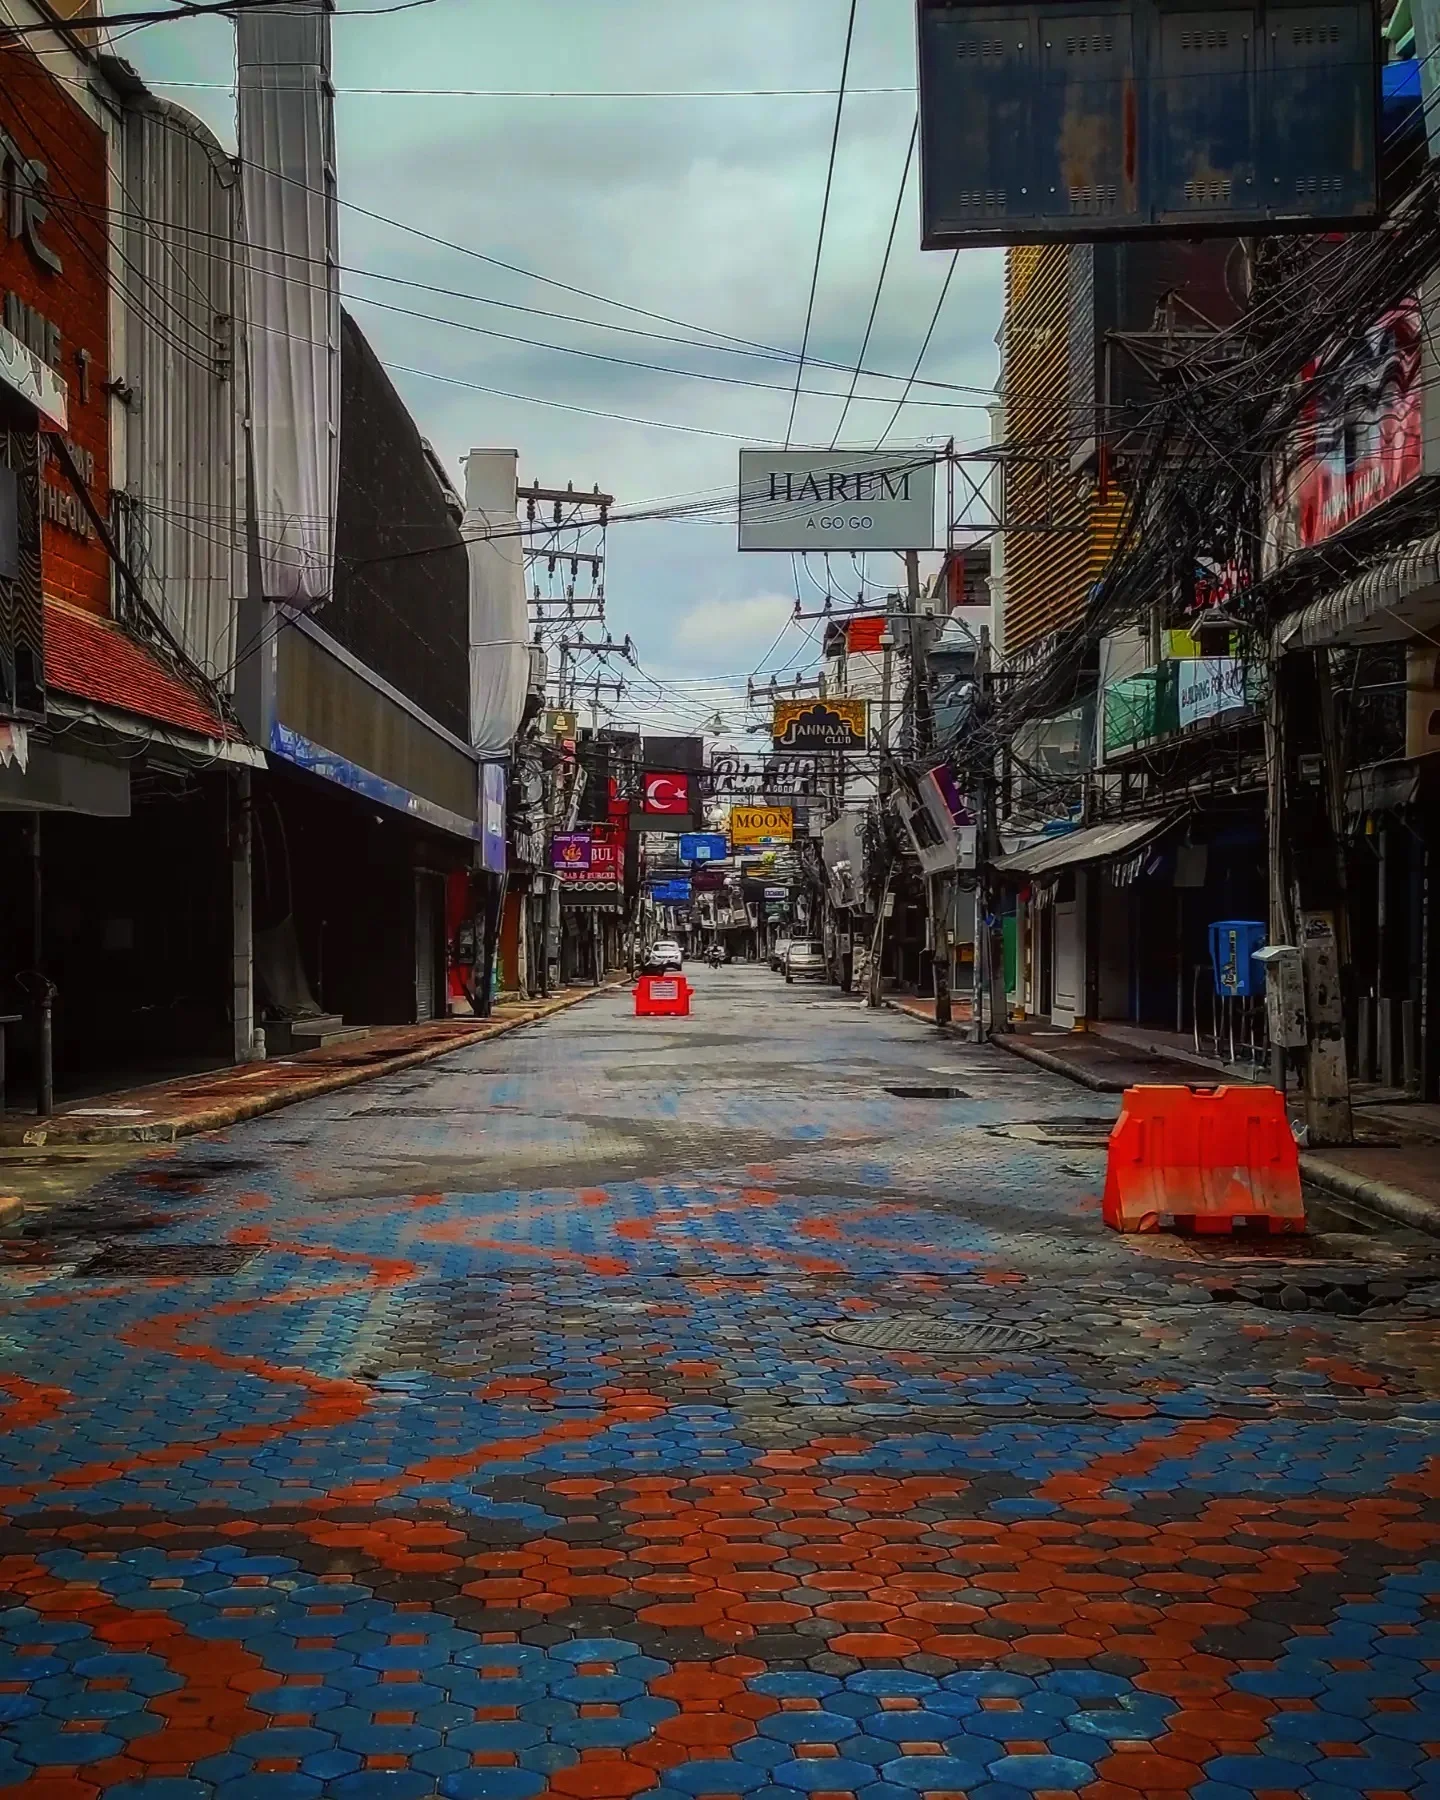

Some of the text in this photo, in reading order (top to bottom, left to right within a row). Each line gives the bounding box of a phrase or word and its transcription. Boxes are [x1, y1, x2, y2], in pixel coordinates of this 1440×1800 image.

[768, 472, 912, 502] HAREM
[806, 516, 873, 530] A GO GO
[780, 722, 852, 745] JANNAAT
[824, 736, 852, 744] CLUB
[736, 813, 791, 829] MOON
